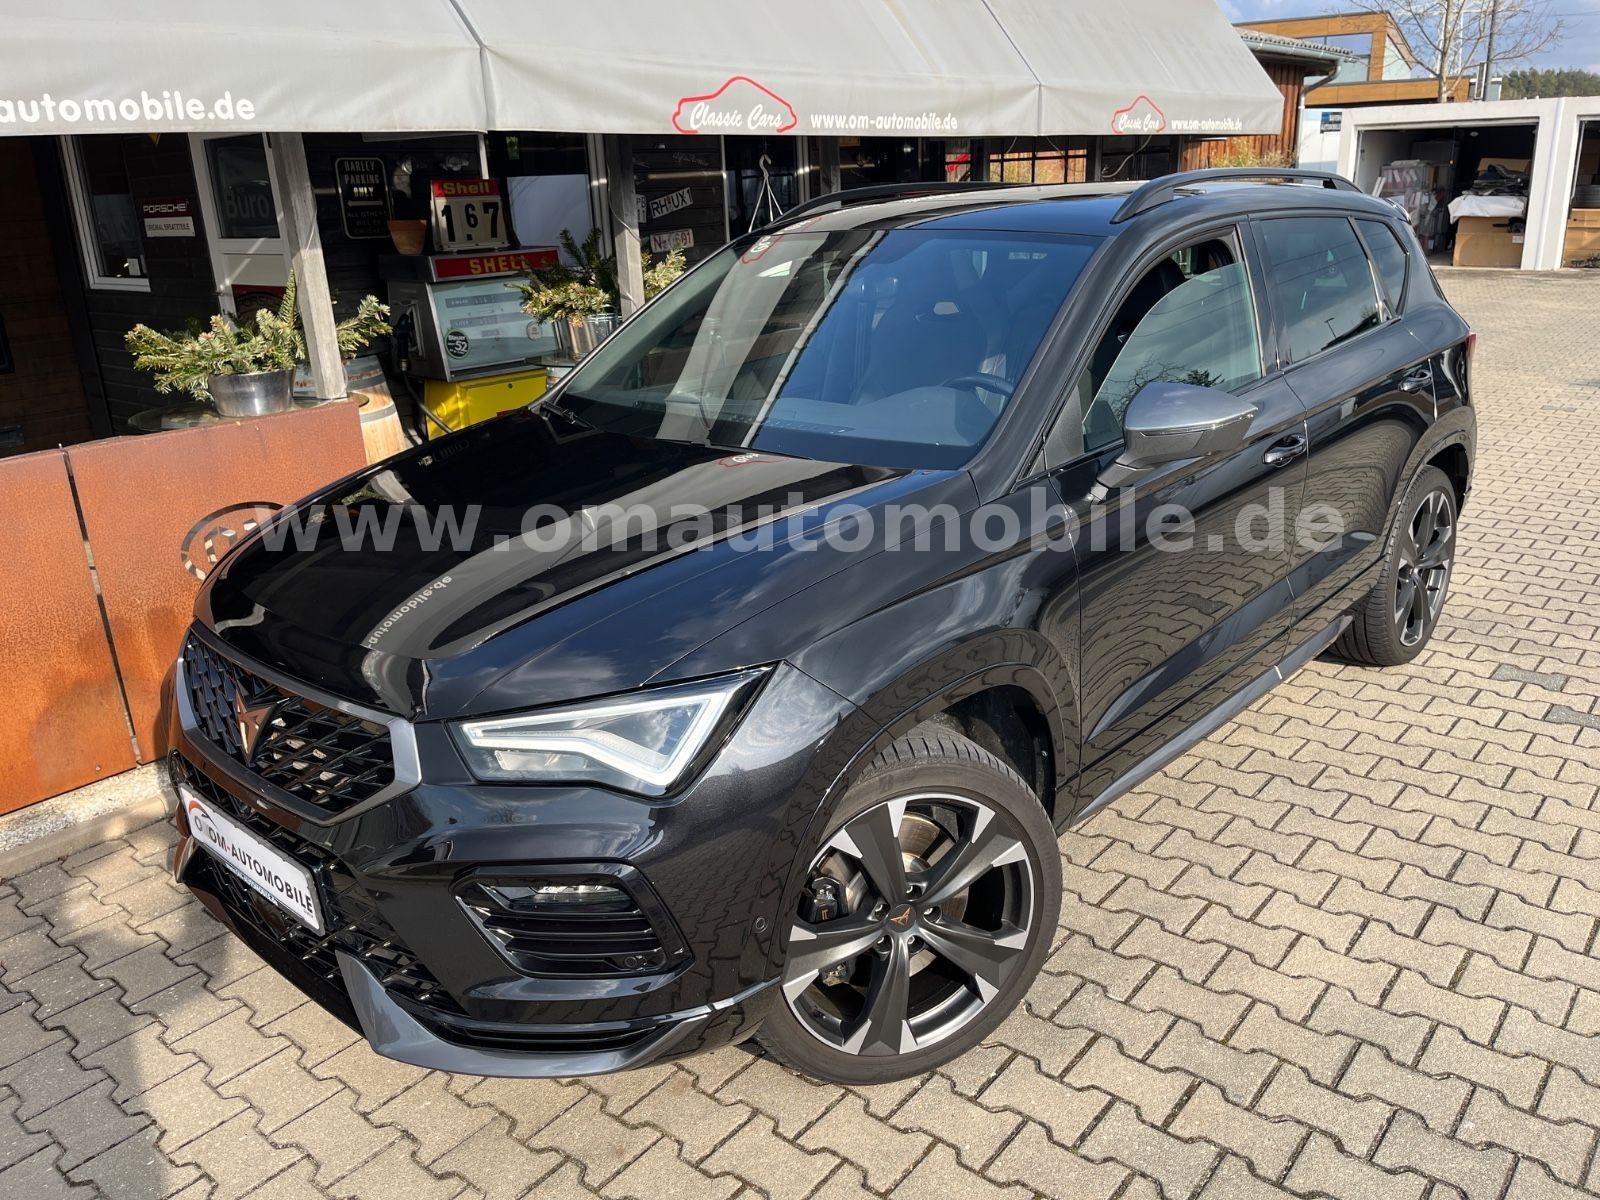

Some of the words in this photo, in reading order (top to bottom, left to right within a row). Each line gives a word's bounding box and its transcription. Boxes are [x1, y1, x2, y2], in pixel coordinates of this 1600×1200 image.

[0, 90, 256, 123] automobile.de
[690, 102, 743, 129] Classic
[747, 104, 783, 130] Cars
[811, 112, 958, 130] www.om-automobile.de
[344, 160, 375, 172] HARLEY
[344, 174, 380, 185] PARKING
[353, 186, 374, 197] ONLY
[443, 181, 490, 195] Shell
[143, 203, 186, 213] PORSCHE
[208, 825, 314, 914] OM-AUTOMOBILE
